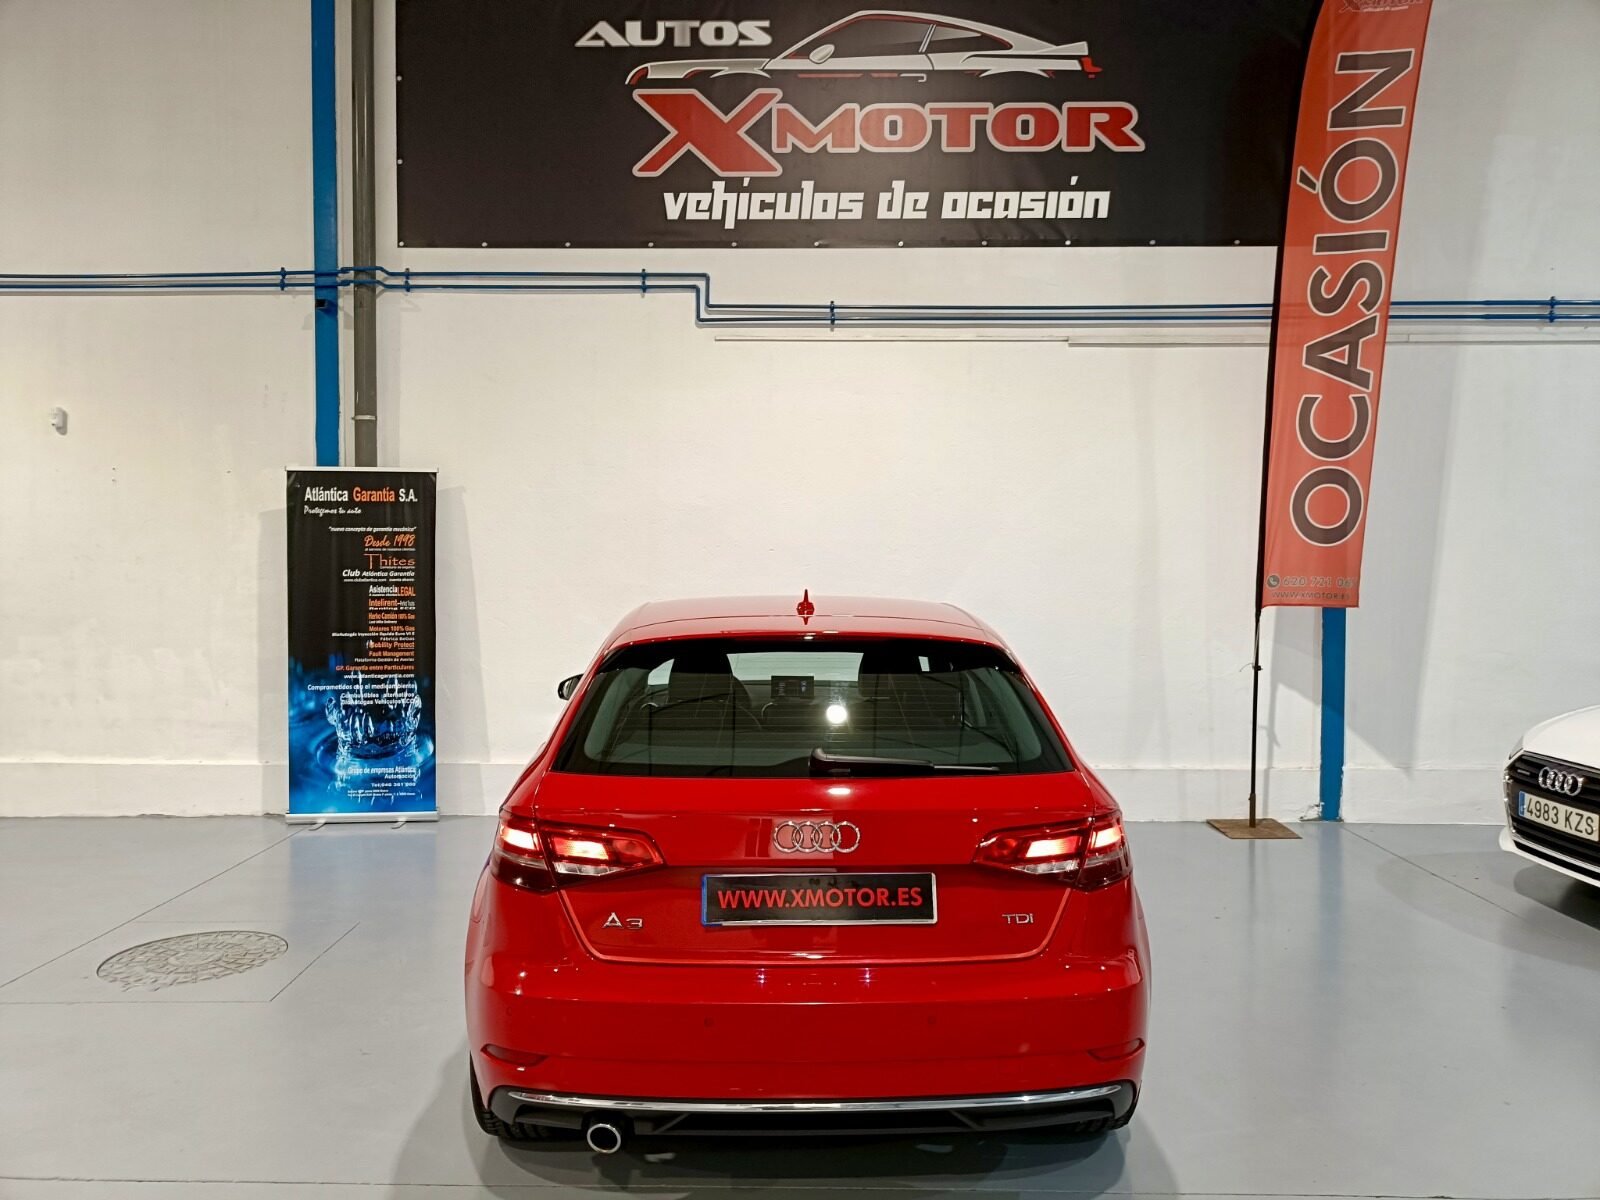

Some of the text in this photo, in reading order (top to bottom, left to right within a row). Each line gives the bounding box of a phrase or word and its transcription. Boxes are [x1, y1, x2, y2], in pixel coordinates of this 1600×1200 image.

[575, 20, 772, 47] AUTOS
[663, 176, 1111, 229] vehículos de ocasión
[1289, 48, 1415, 547] OCASIÓN
[304, 486, 419, 503] Atlántica Garantía S.A.
[364, 534, 416, 548] Desde 1998
[363, 553, 416, 570] Thites
[342, 569, 361, 577] Club
[1282, 575, 1307, 587] 620
[1526, 797, 1595, 836] 4983 KZS
[717, 887, 924, 910] WWW.XMOTOR.ES
[602, 911, 644, 930] A3
